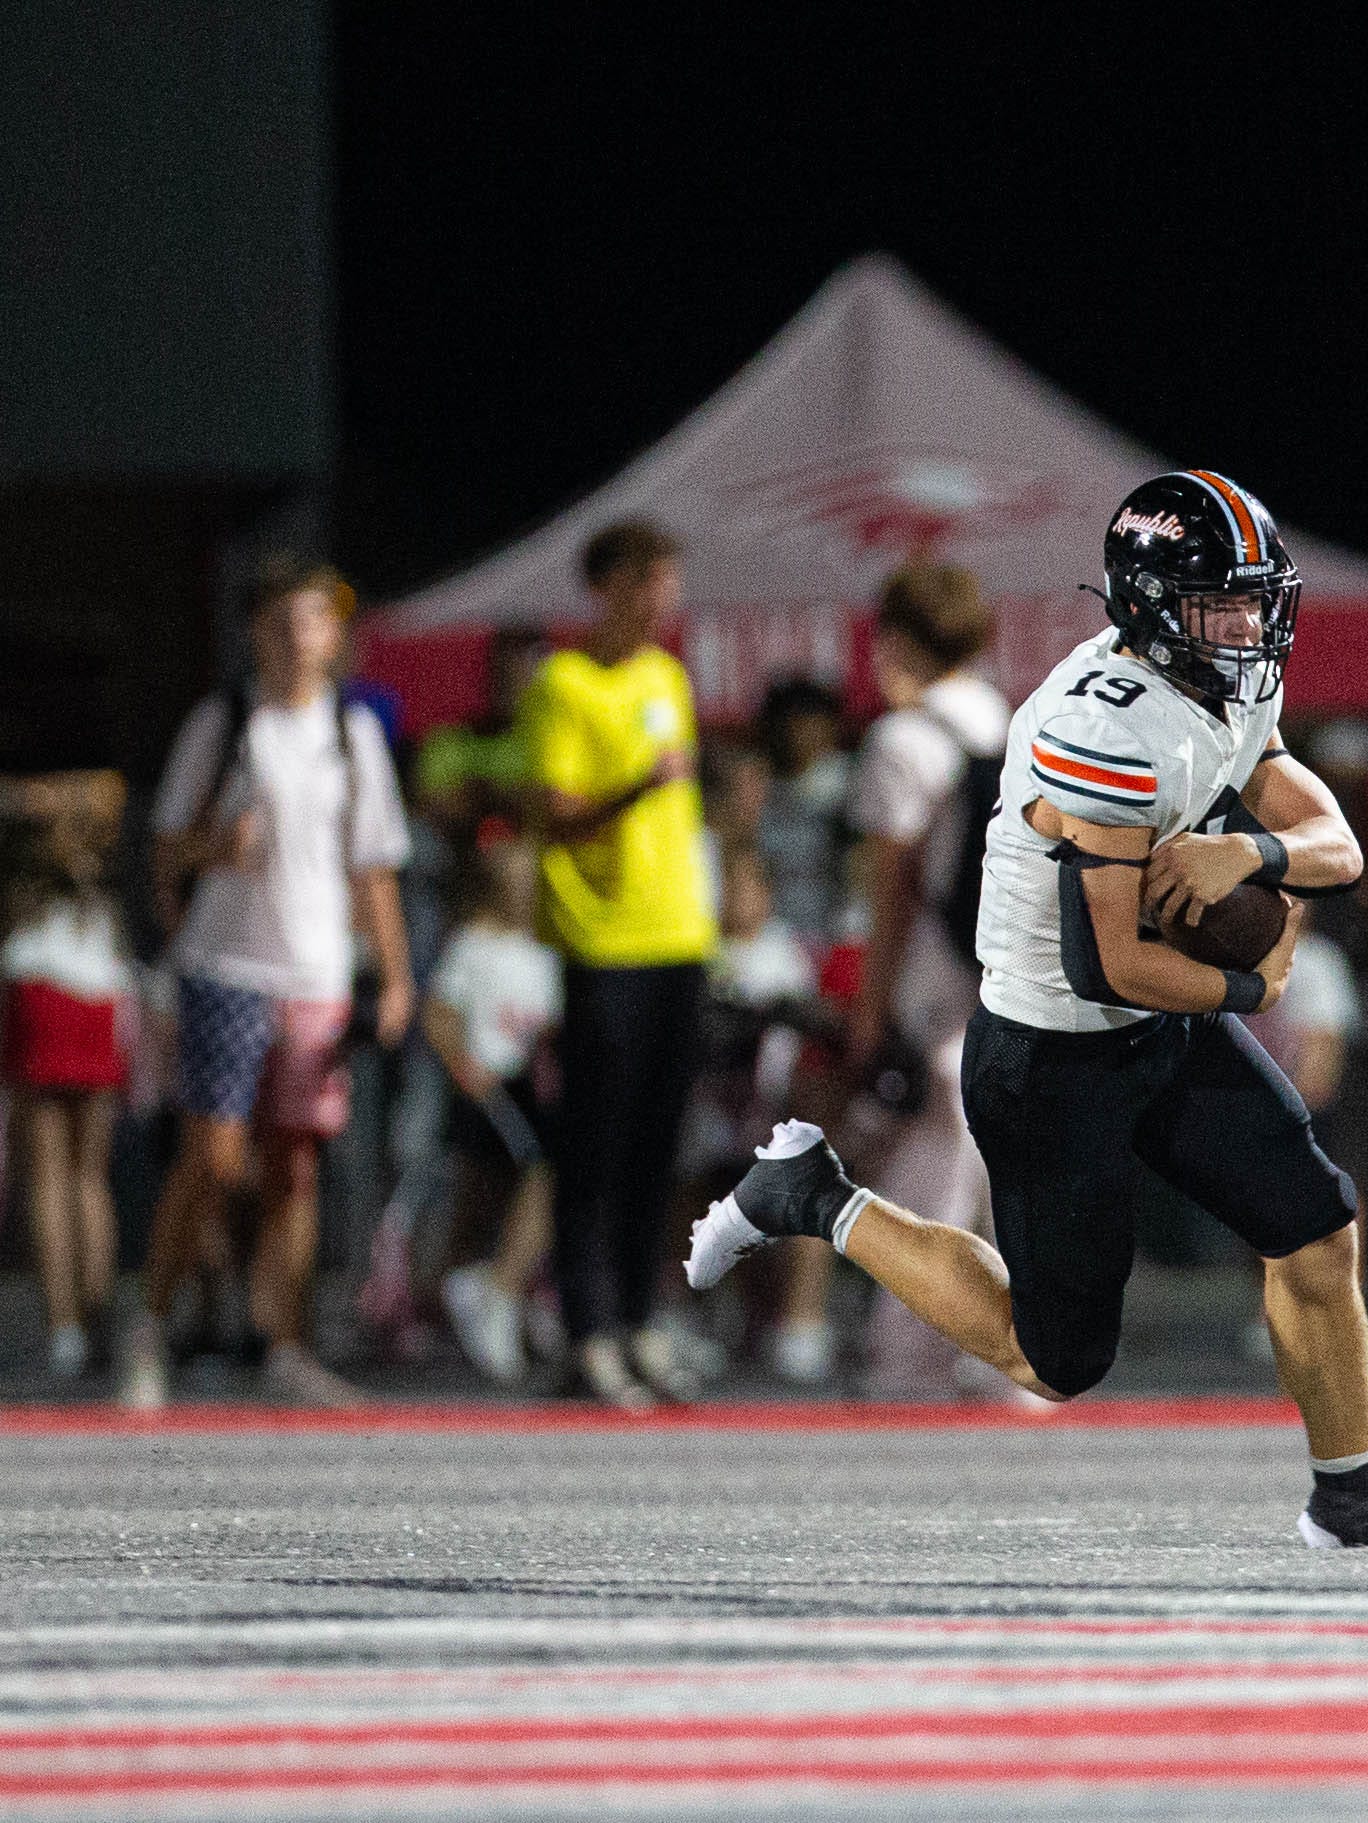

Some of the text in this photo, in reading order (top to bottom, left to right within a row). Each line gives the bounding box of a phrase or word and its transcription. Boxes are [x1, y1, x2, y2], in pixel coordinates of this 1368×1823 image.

[1112, 506, 1185, 541] Republic
[1236, 562, 1275, 577] Riddell
[1065, 670, 1148, 708] 19
